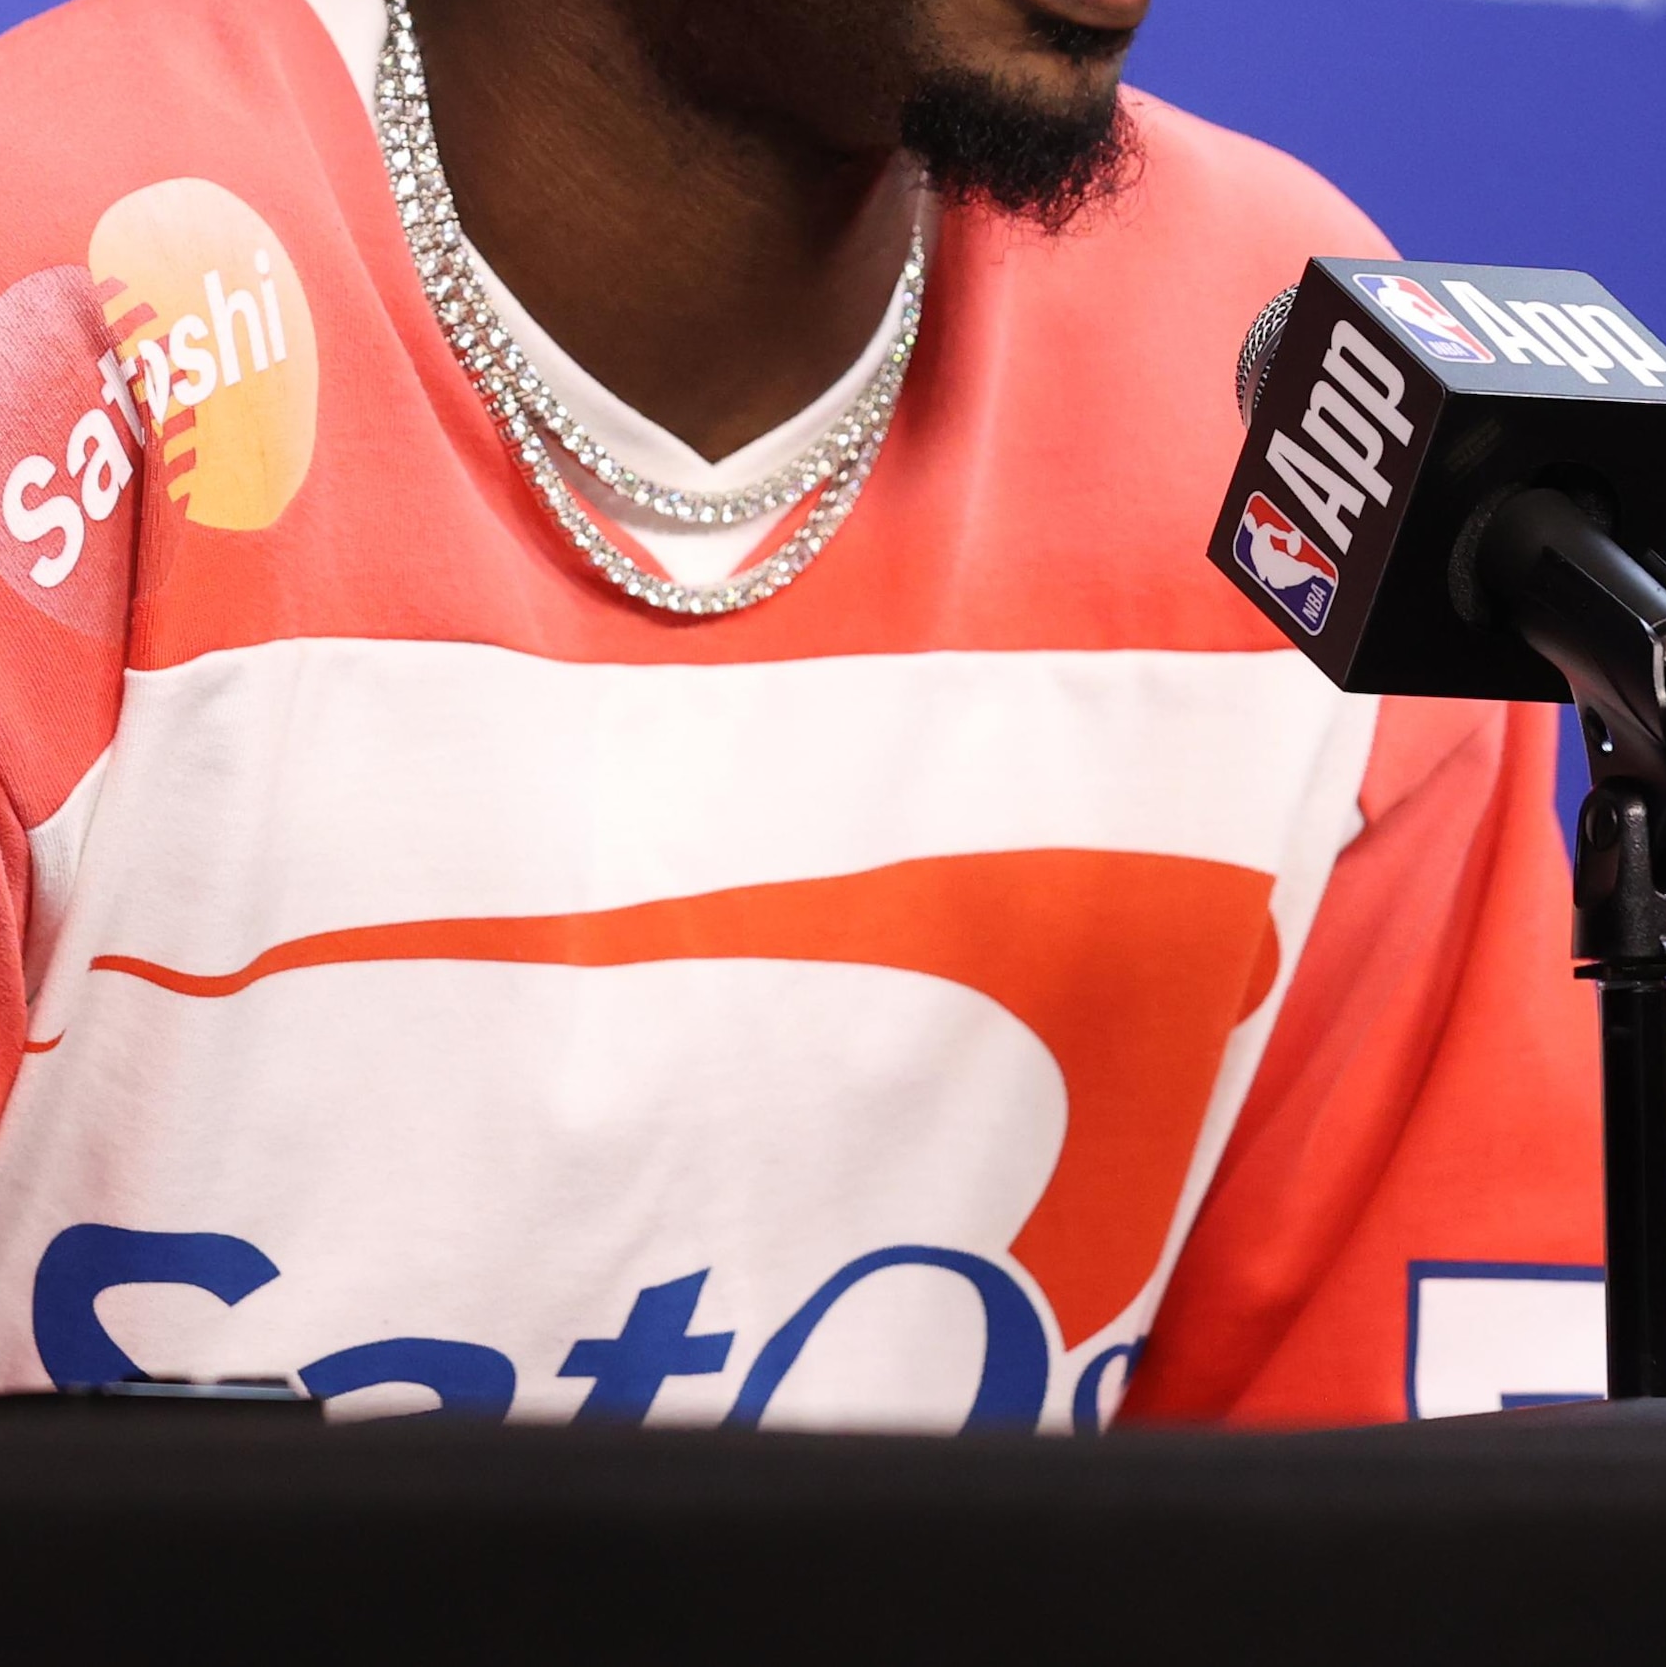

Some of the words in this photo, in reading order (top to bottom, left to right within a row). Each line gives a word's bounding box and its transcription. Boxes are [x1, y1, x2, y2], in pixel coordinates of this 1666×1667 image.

[1428, 340, 1470, 358] NBA
[1265, 319, 1416, 556] App
[1301, 584, 1328, 623] NBA
